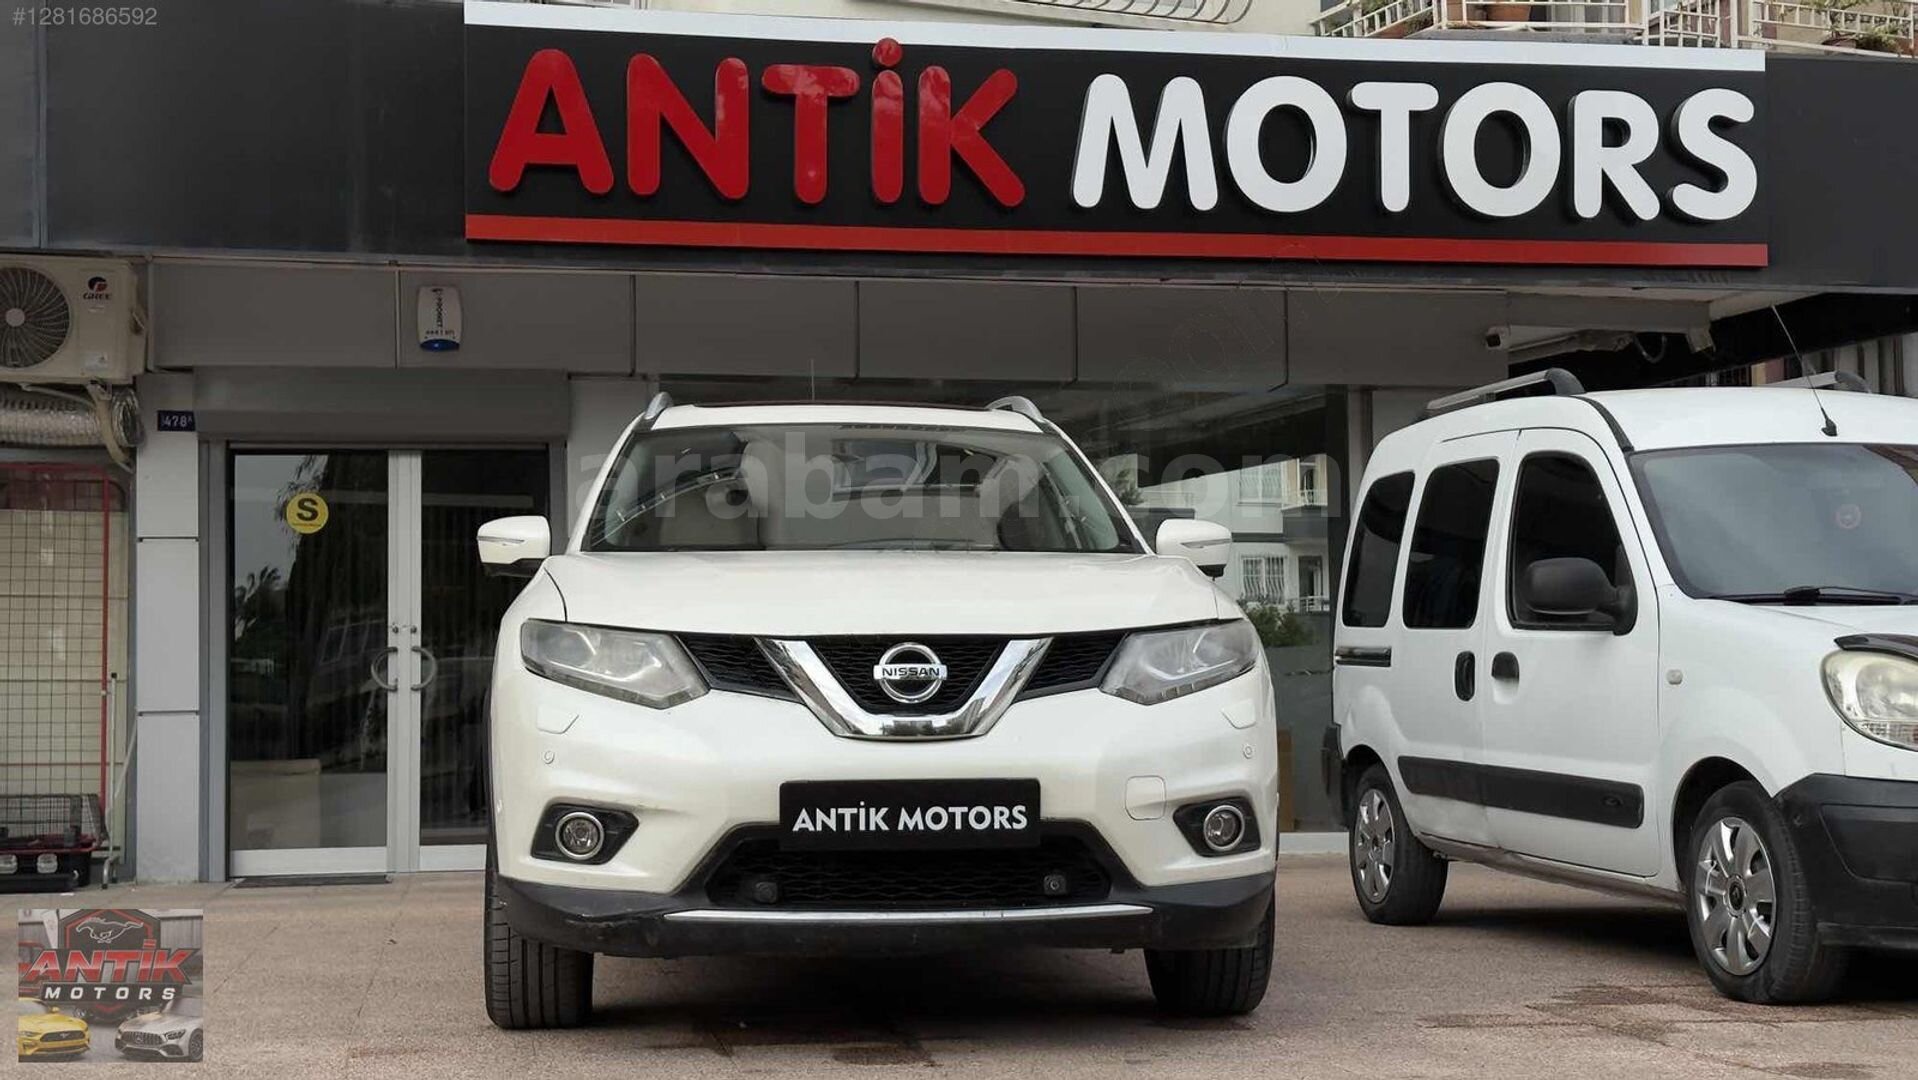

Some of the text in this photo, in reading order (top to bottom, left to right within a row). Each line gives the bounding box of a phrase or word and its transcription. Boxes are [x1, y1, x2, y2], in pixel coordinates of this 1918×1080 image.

[489, 37, 1758, 222] ANTİK MOTORS
[296, 497, 319, 522] S
[882, 667, 940, 677] NISSAN
[792, 800, 1028, 832] ANTİK MOTORS
